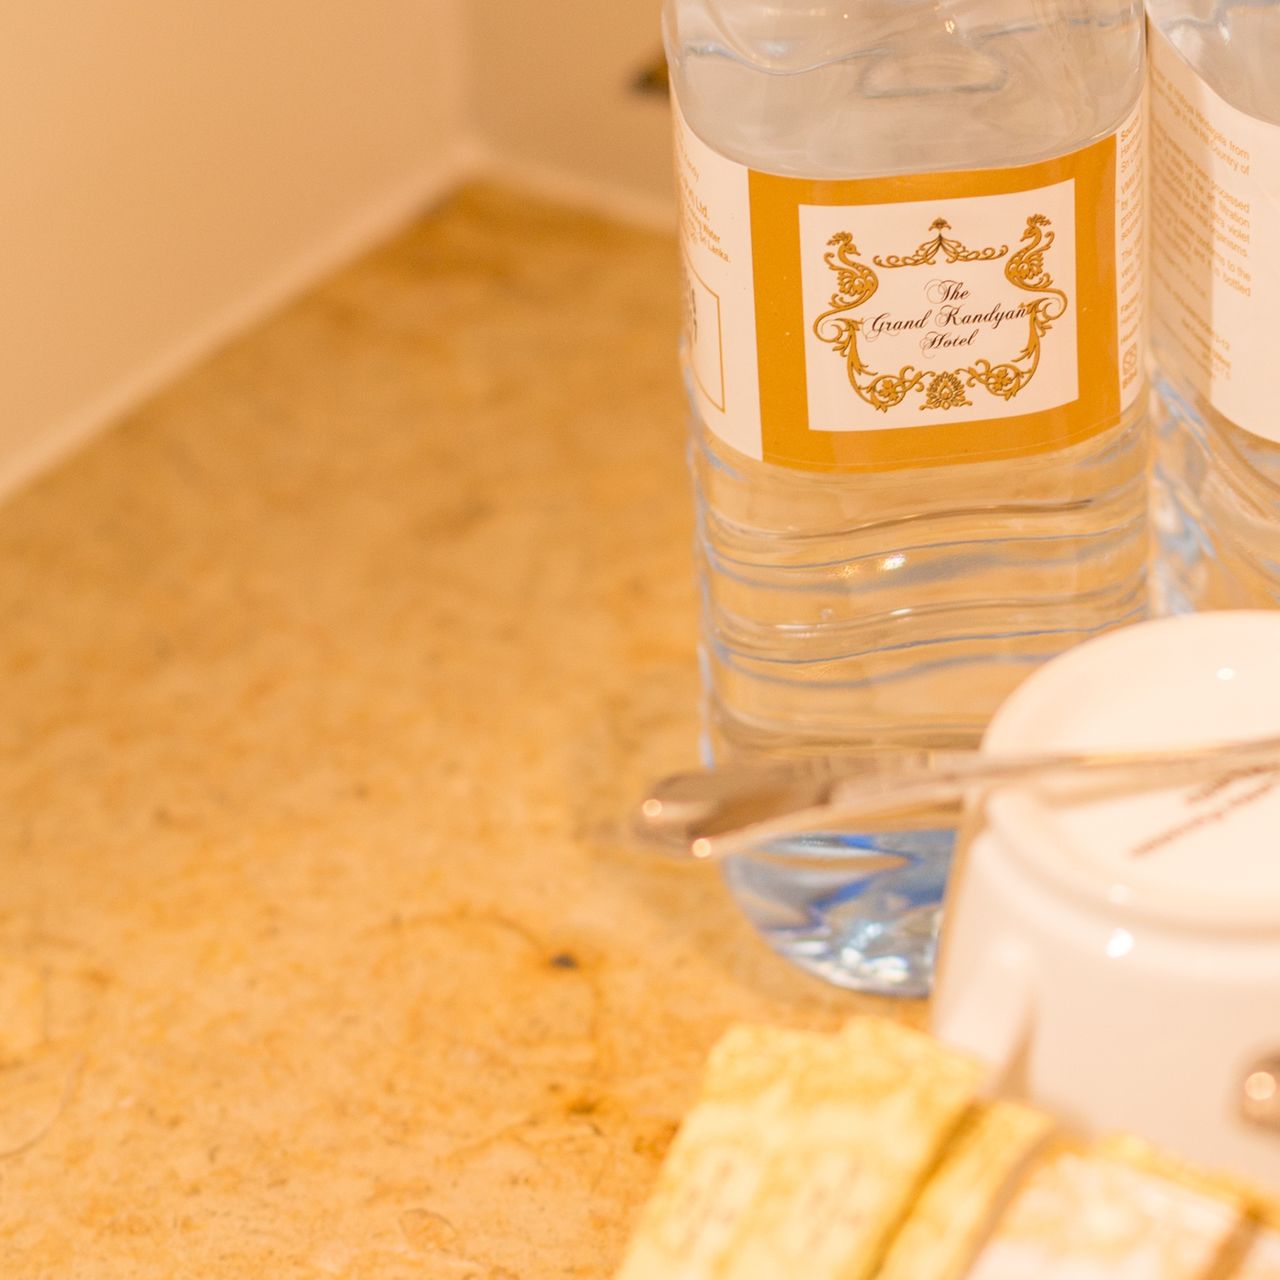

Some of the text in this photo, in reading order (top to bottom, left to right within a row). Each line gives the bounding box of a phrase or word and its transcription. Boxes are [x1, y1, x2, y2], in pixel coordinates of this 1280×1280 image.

[924, 278, 970, 304] The
[862, 309, 933, 343] Grand
[919, 328, 980, 360] Hotel
